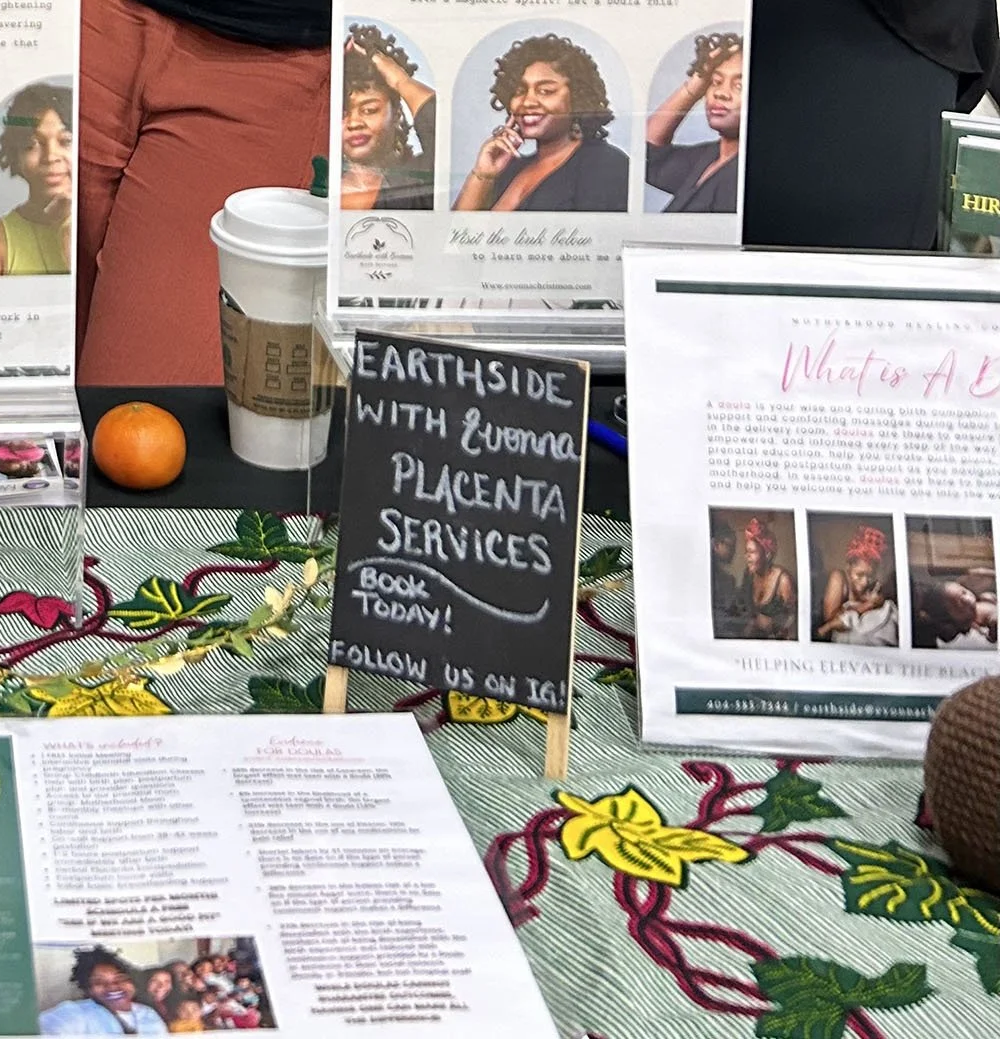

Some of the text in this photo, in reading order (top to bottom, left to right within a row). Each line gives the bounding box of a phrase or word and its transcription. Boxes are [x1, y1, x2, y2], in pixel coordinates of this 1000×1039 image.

[357, 340, 574, 408] EARTHSIDE
[880, 362, 911, 388] is
[922, 349, 957, 398] A
[356, 394, 446, 438] WITH
[391, 451, 566, 523] PLACENTA
[377, 507, 553, 575] SERVICES
[360, 566, 431, 599] BOOK
[351, 588, 453, 634] TODAY!
[330, 639, 427, 680] FOLLOW
[445, 663, 475, 688] US
[484, 672, 517, 697] ON
